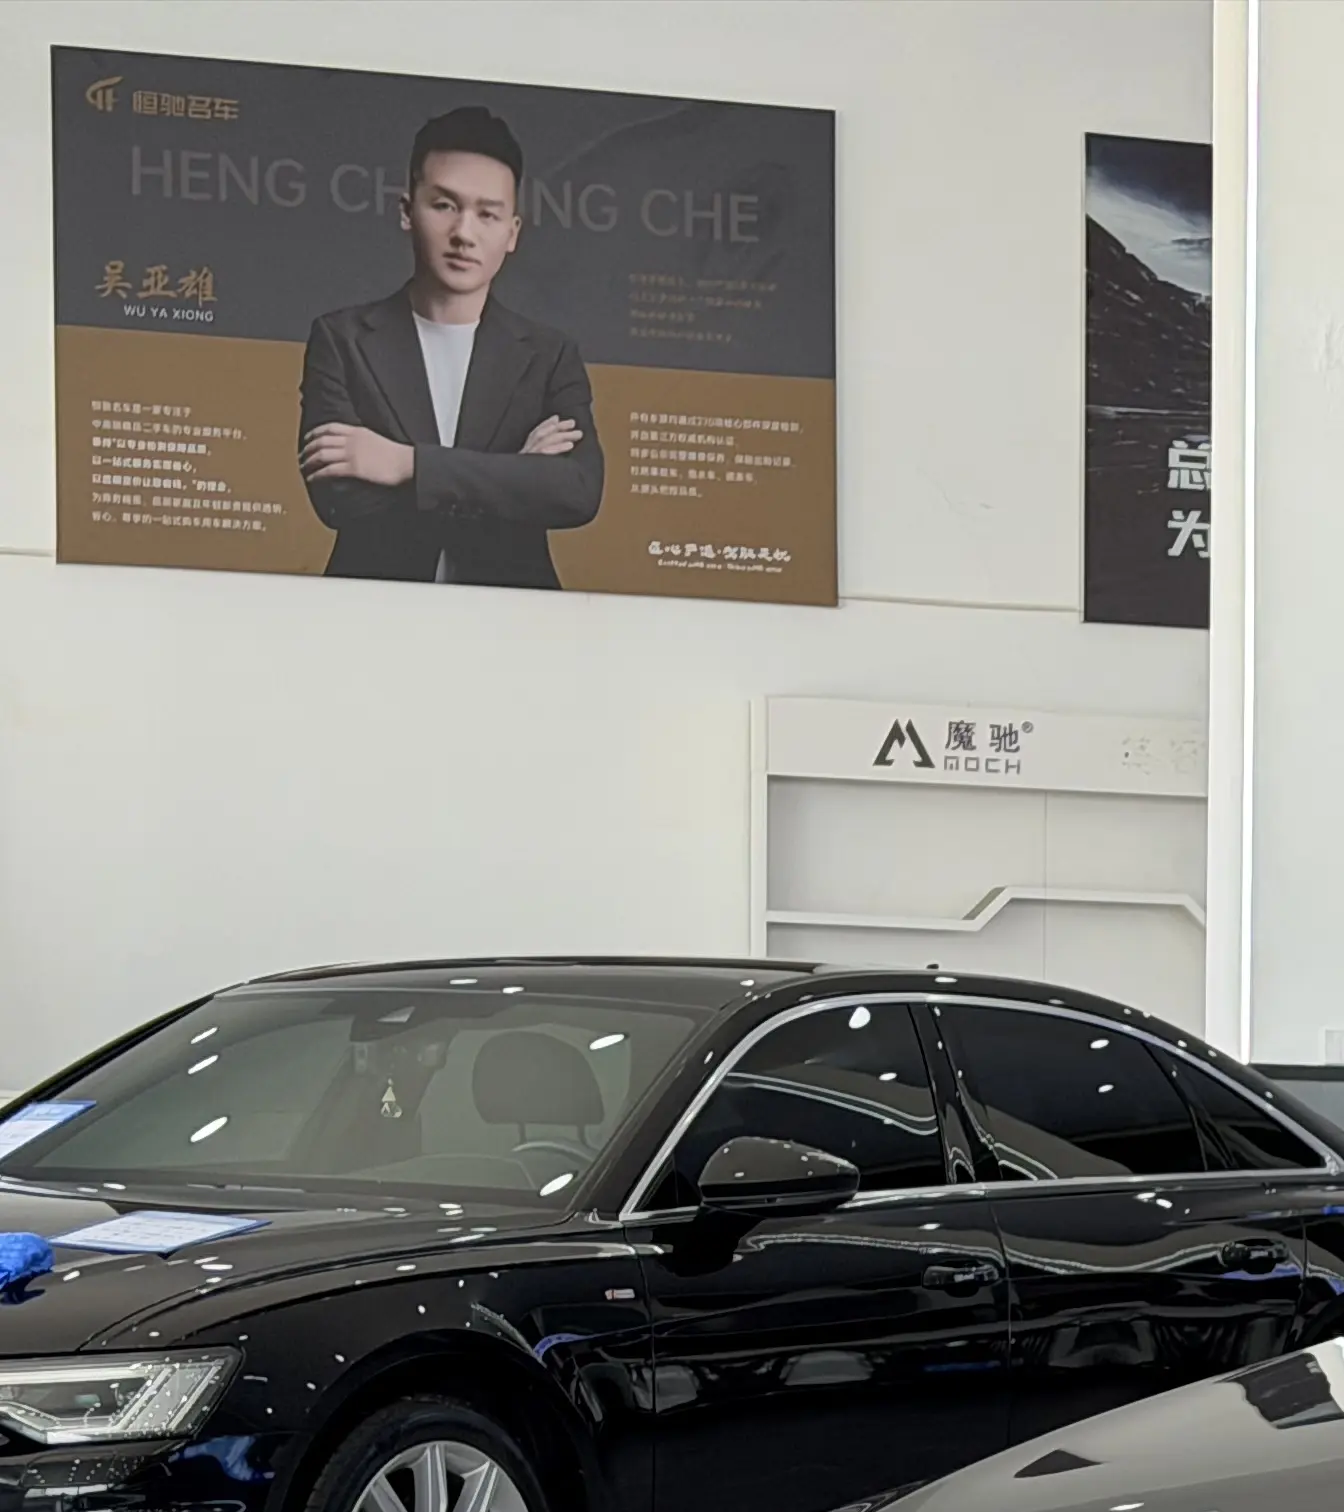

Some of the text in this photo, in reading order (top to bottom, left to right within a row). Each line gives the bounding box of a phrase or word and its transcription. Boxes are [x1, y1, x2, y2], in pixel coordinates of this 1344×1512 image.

[132, 90, 240, 120] 恒驰名车
[132, 146, 306, 208] HENG
[330, 164, 411, 217] CH
[641, 189, 760, 243] CHE
[94, 260, 218, 306] 吴亚雄
[123, 304, 215, 322] WU YA XIONG
